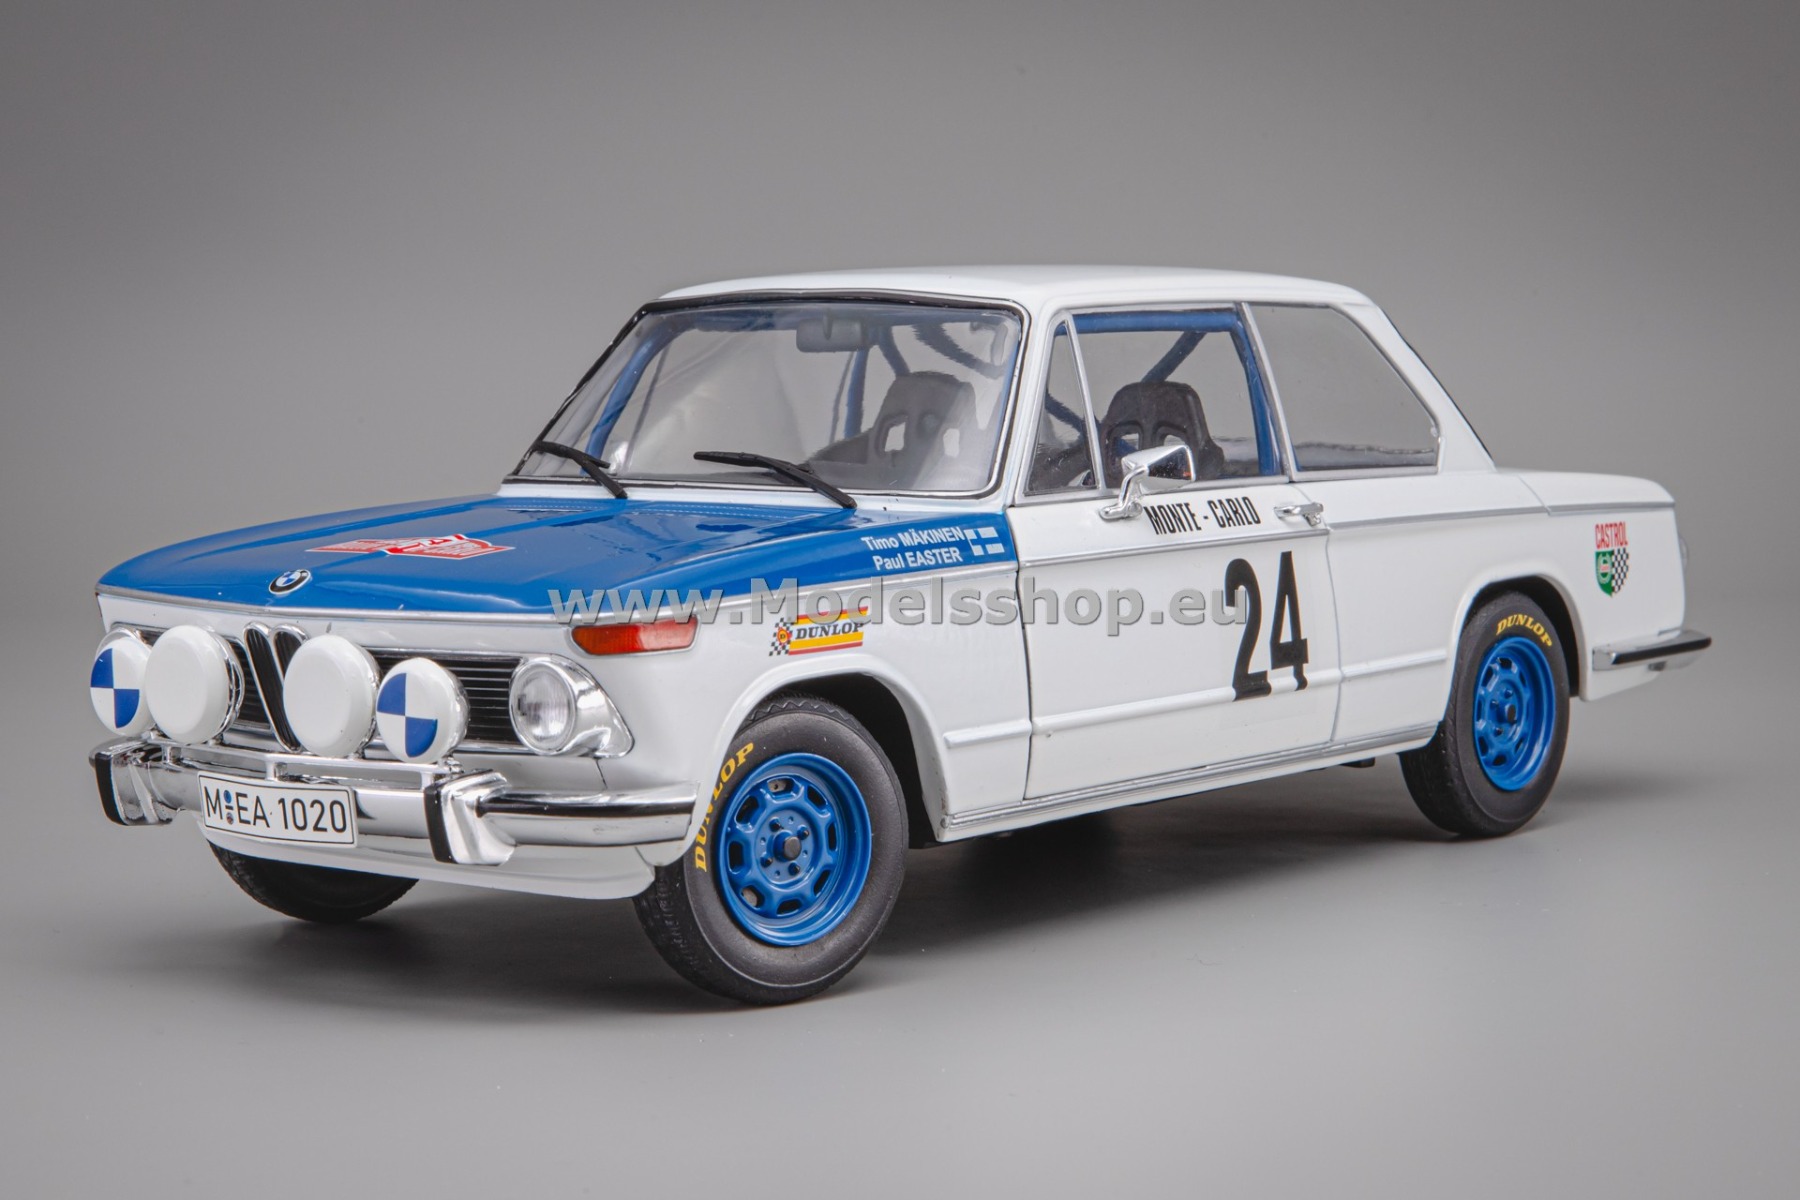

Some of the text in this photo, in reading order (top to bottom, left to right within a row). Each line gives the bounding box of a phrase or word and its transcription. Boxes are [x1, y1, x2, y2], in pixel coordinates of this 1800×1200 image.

[1143, 502, 1202, 535] MONTE
[1207, 496, 1262, 528] CARLO
[861, 526, 965, 551] Timo MÄKINEN
[1595, 521, 1628, 549] CASTROL
[873, 547, 963, 571] Paul EASTER
[795, 622, 864, 640] DUNLOP
[1225, 551, 1309, 702] 24
[1496, 614, 1553, 647] DUNLOP
[278, 797, 347, 833] 1020
